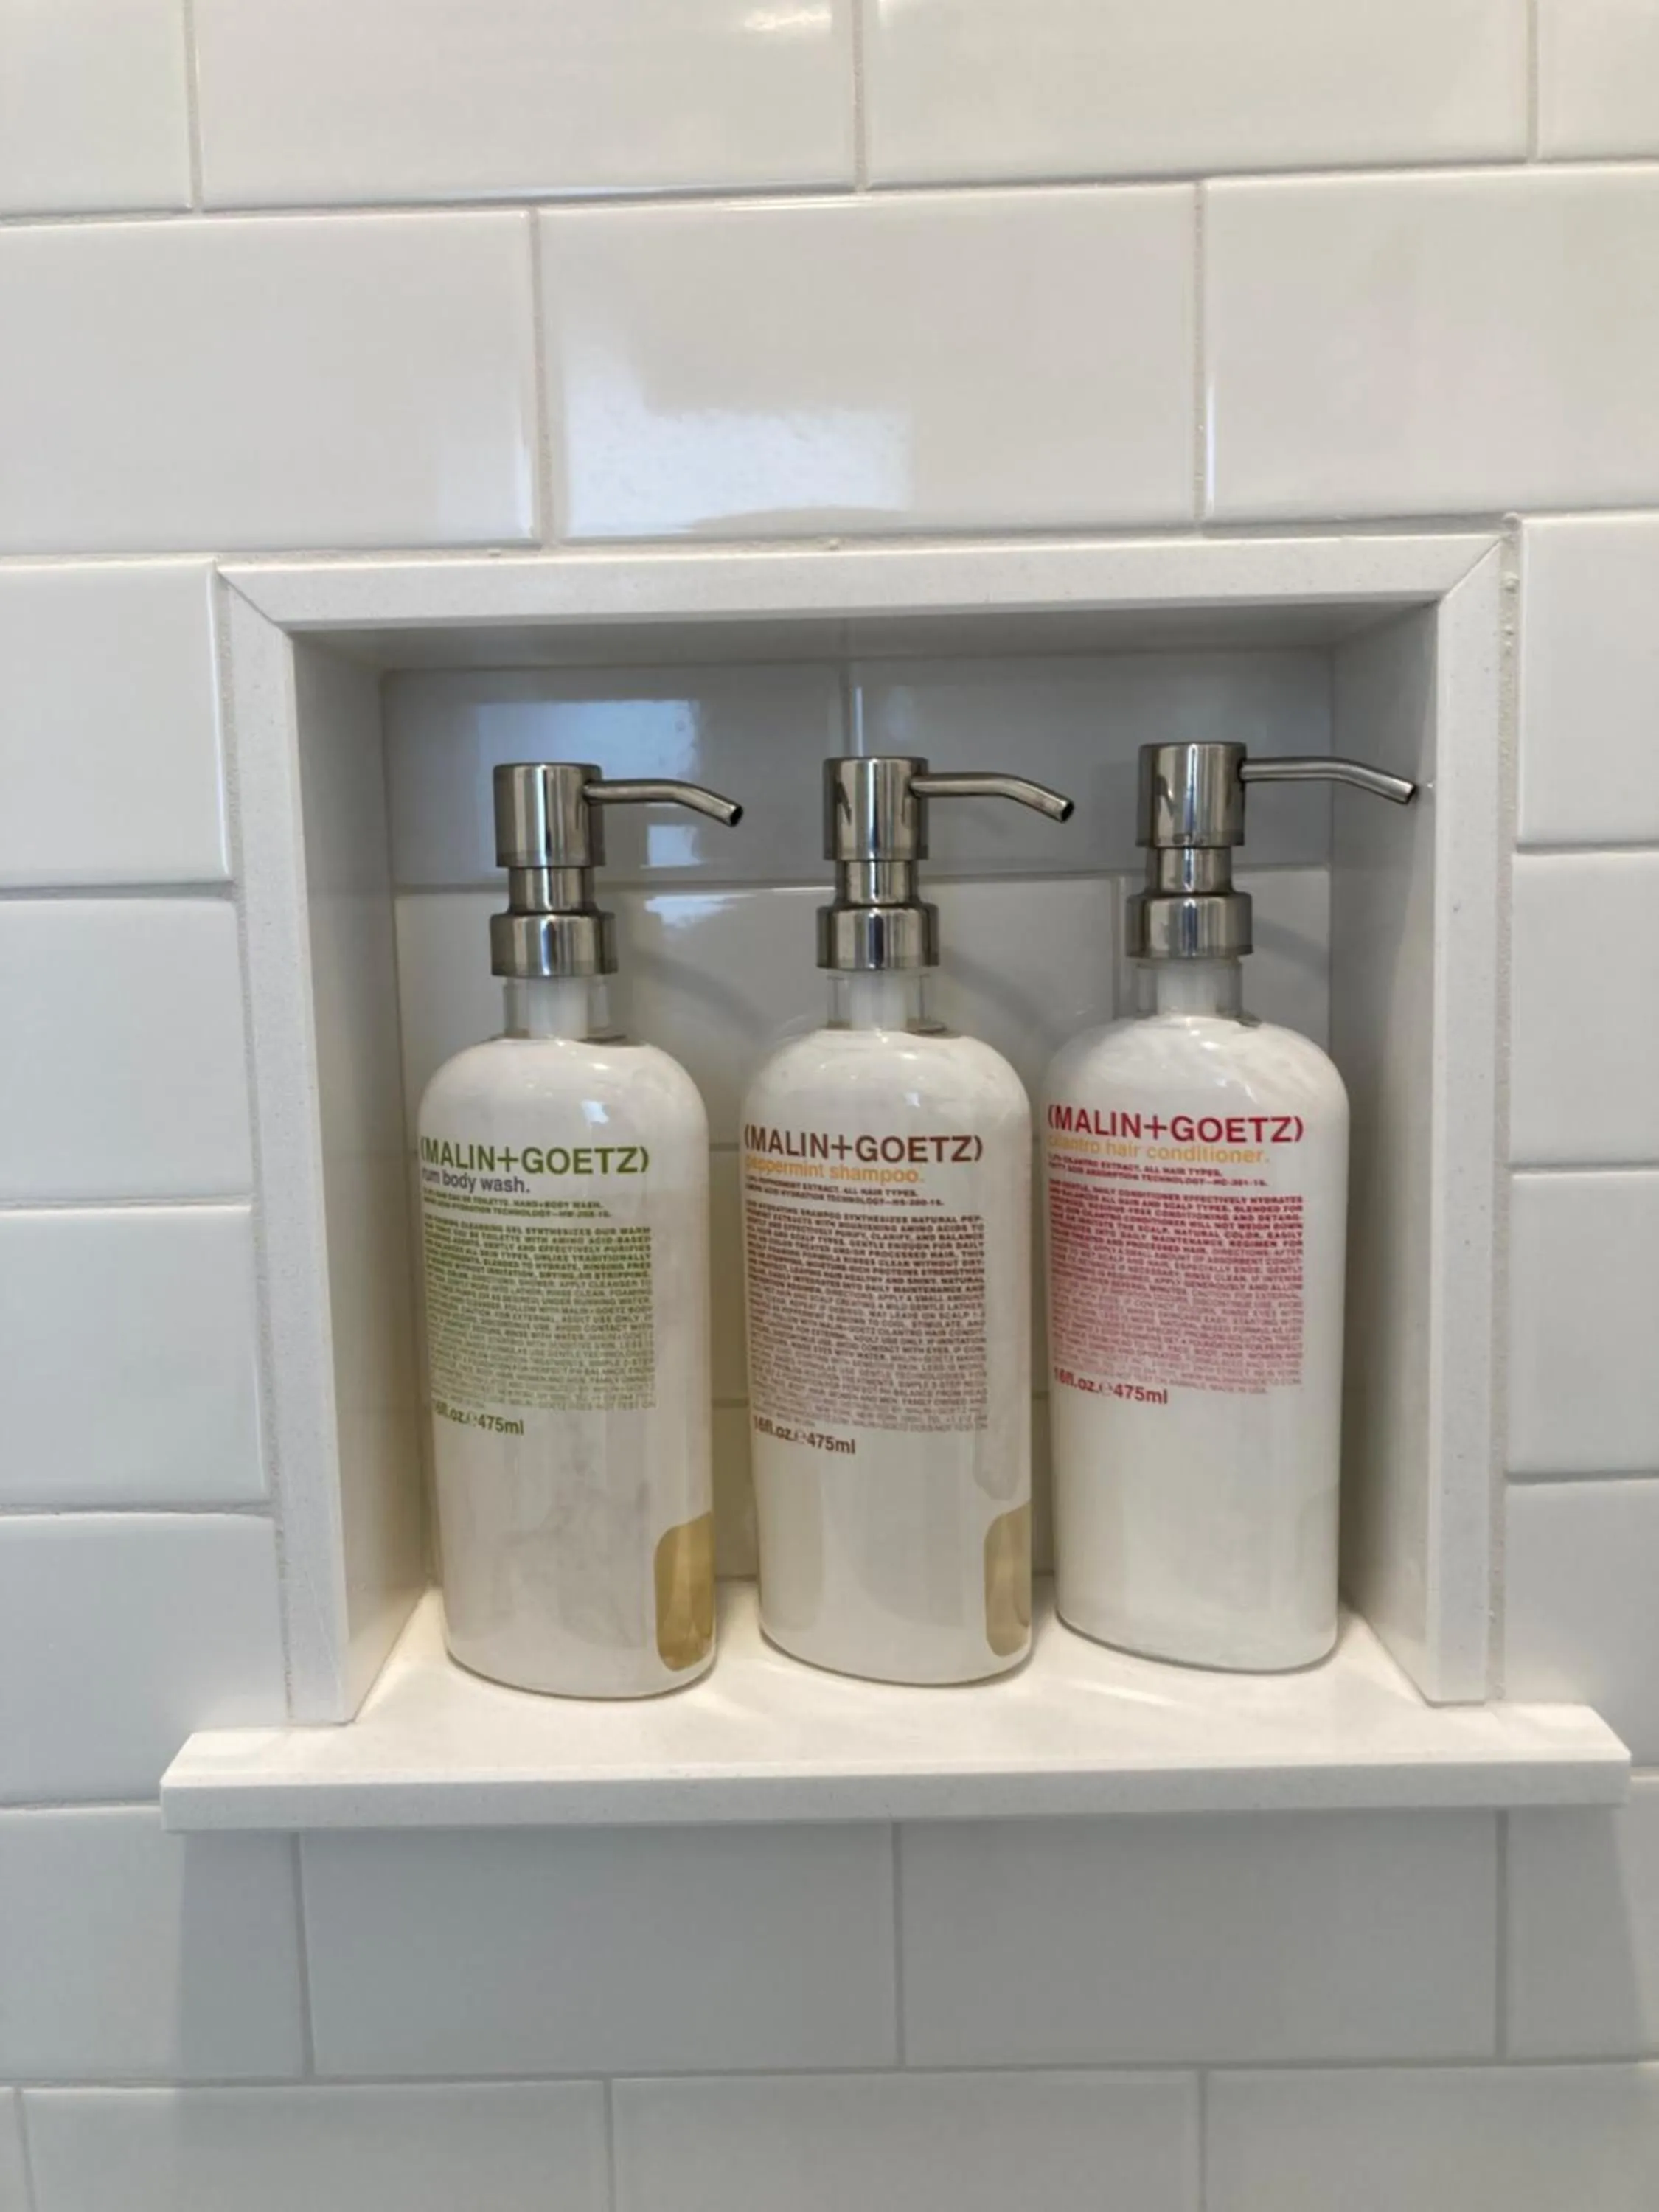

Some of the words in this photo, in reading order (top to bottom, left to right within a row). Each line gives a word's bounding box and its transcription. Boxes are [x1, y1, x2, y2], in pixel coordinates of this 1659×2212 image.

[1048, 1105, 1304, 1144] (MALIN+GOETZ)
[421, 1136, 650, 1175] (MALIN+GOETZ)
[745, 1124, 983, 1163] (MALIN+GOETZ)
[1105, 1140, 1140, 1158] hair
[1147, 1146, 1270, 1164] conditioner.
[442, 1169, 476, 1194] body
[481, 1176, 531, 1193] wash.
[830, 1163, 925, 1185] shampoo.
